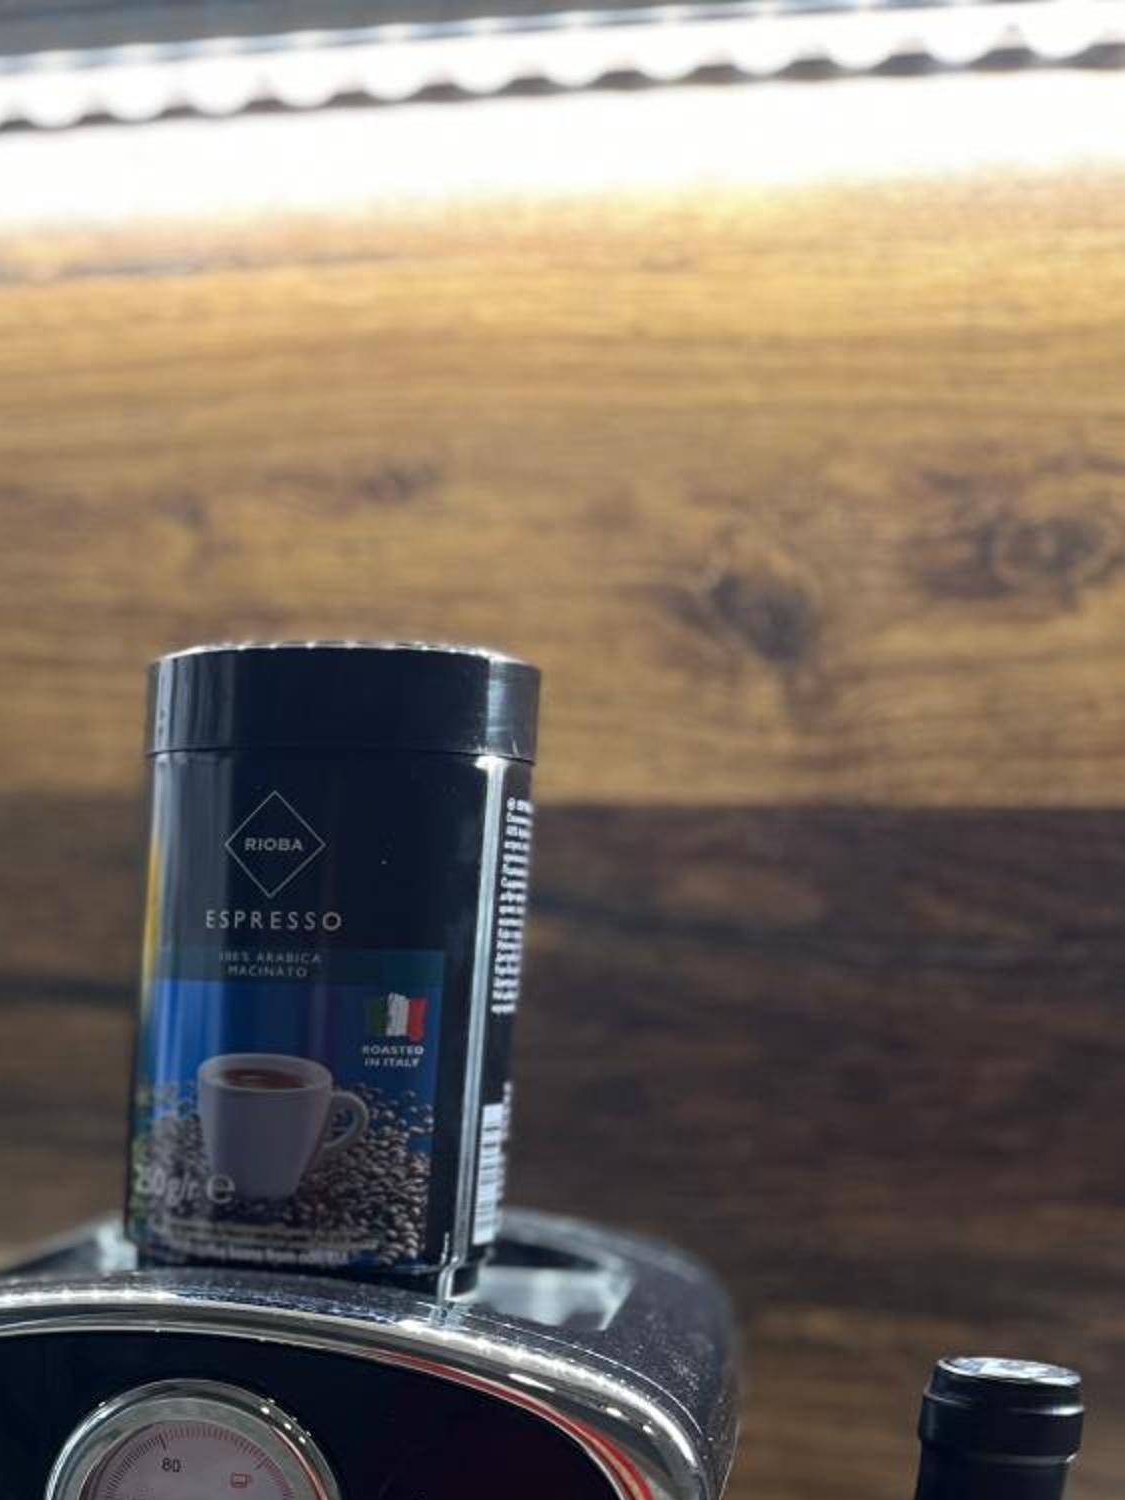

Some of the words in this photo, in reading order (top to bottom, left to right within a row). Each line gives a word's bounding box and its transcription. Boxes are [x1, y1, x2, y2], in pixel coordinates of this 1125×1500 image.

[244, 837, 305, 851] RIOBA
[205, 910, 343, 931] ESPRESSO
[256, 952, 323, 964] ARABICA
[227, 965, 308, 977] MACINATO
[362, 1045, 424, 1055] ROASTED
[364, 1057, 380, 1067] IN
[383, 1057, 420, 1068] ITALY
[161, 1458, 181, 1473] 80
